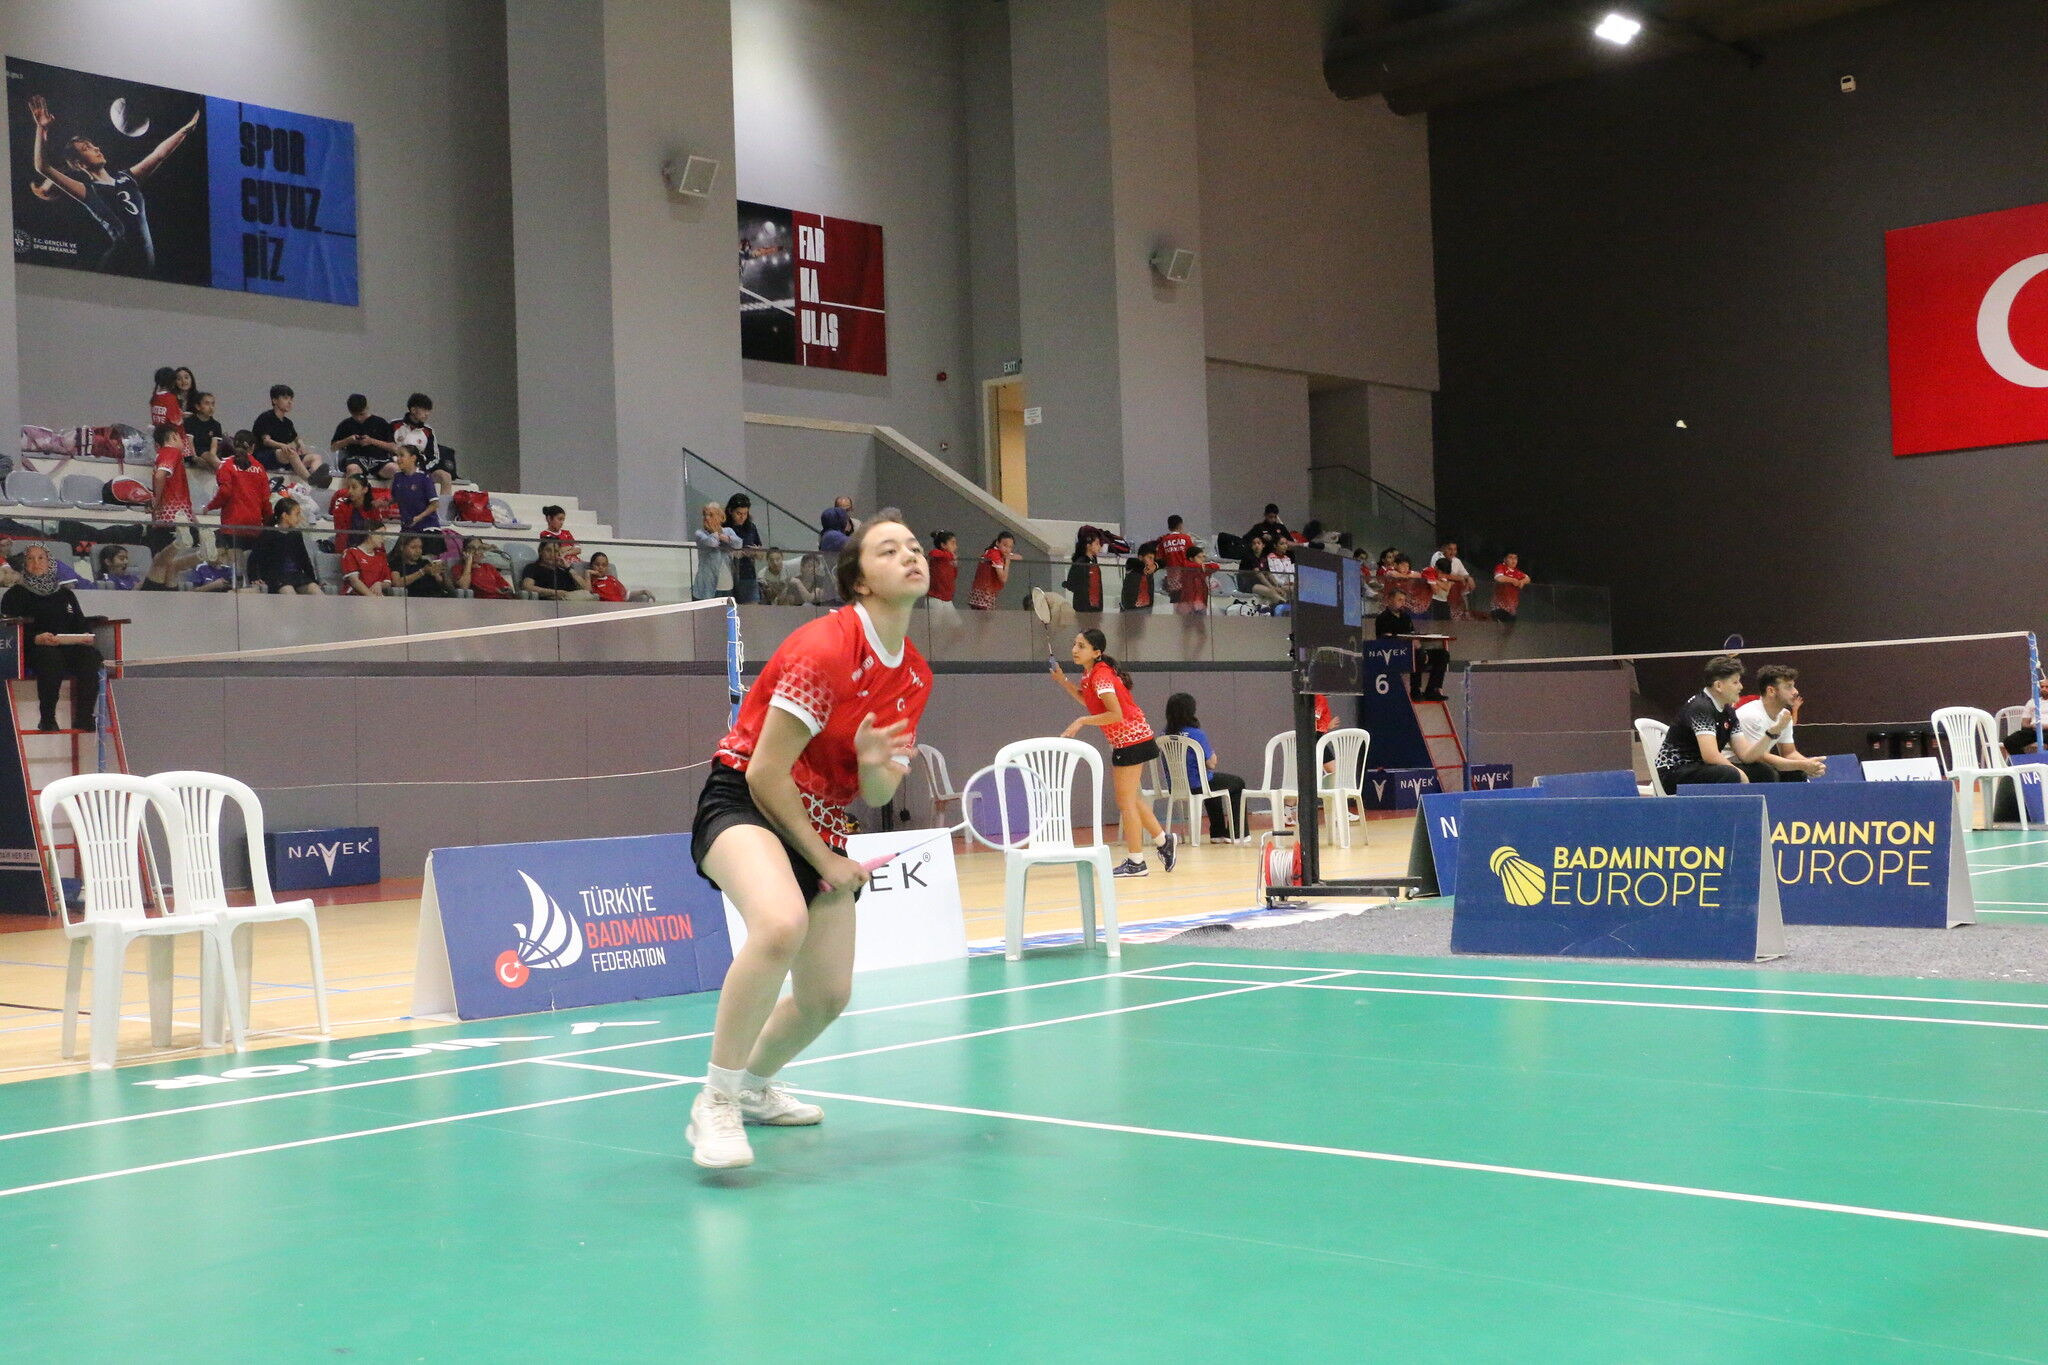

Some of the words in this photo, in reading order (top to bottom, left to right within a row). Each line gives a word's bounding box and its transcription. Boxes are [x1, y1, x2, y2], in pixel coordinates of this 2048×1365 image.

[239, 122, 306, 176] SPOR
[117, 190, 139, 215] 3
[241, 178, 322, 232] CUYUZ
[242, 230, 285, 282] BİZ
[799, 225, 825, 263] FAR
[800, 267, 819, 303] KA
[801, 309, 839, 351] ULAŞ
[1368, 650, 1405, 665] NAVEK
[1375, 674, 1390, 695] 6
[1400, 778, 1433, 800] NAVEK
[1473, 772, 1510, 791] NAVEK
[1770, 821, 1935, 845] ADMINTON
[288, 841, 370, 876] NAVEK
[1554, 846, 1725, 870] BADMINTON
[1777, 849, 1932, 886] UROPE
[579, 882, 657, 917] TÜRKİYE
[1552, 872, 1722, 907] EUROPE
[585, 912, 694, 949] BADMİNTON
[591, 946, 667, 973] FEDERATION
